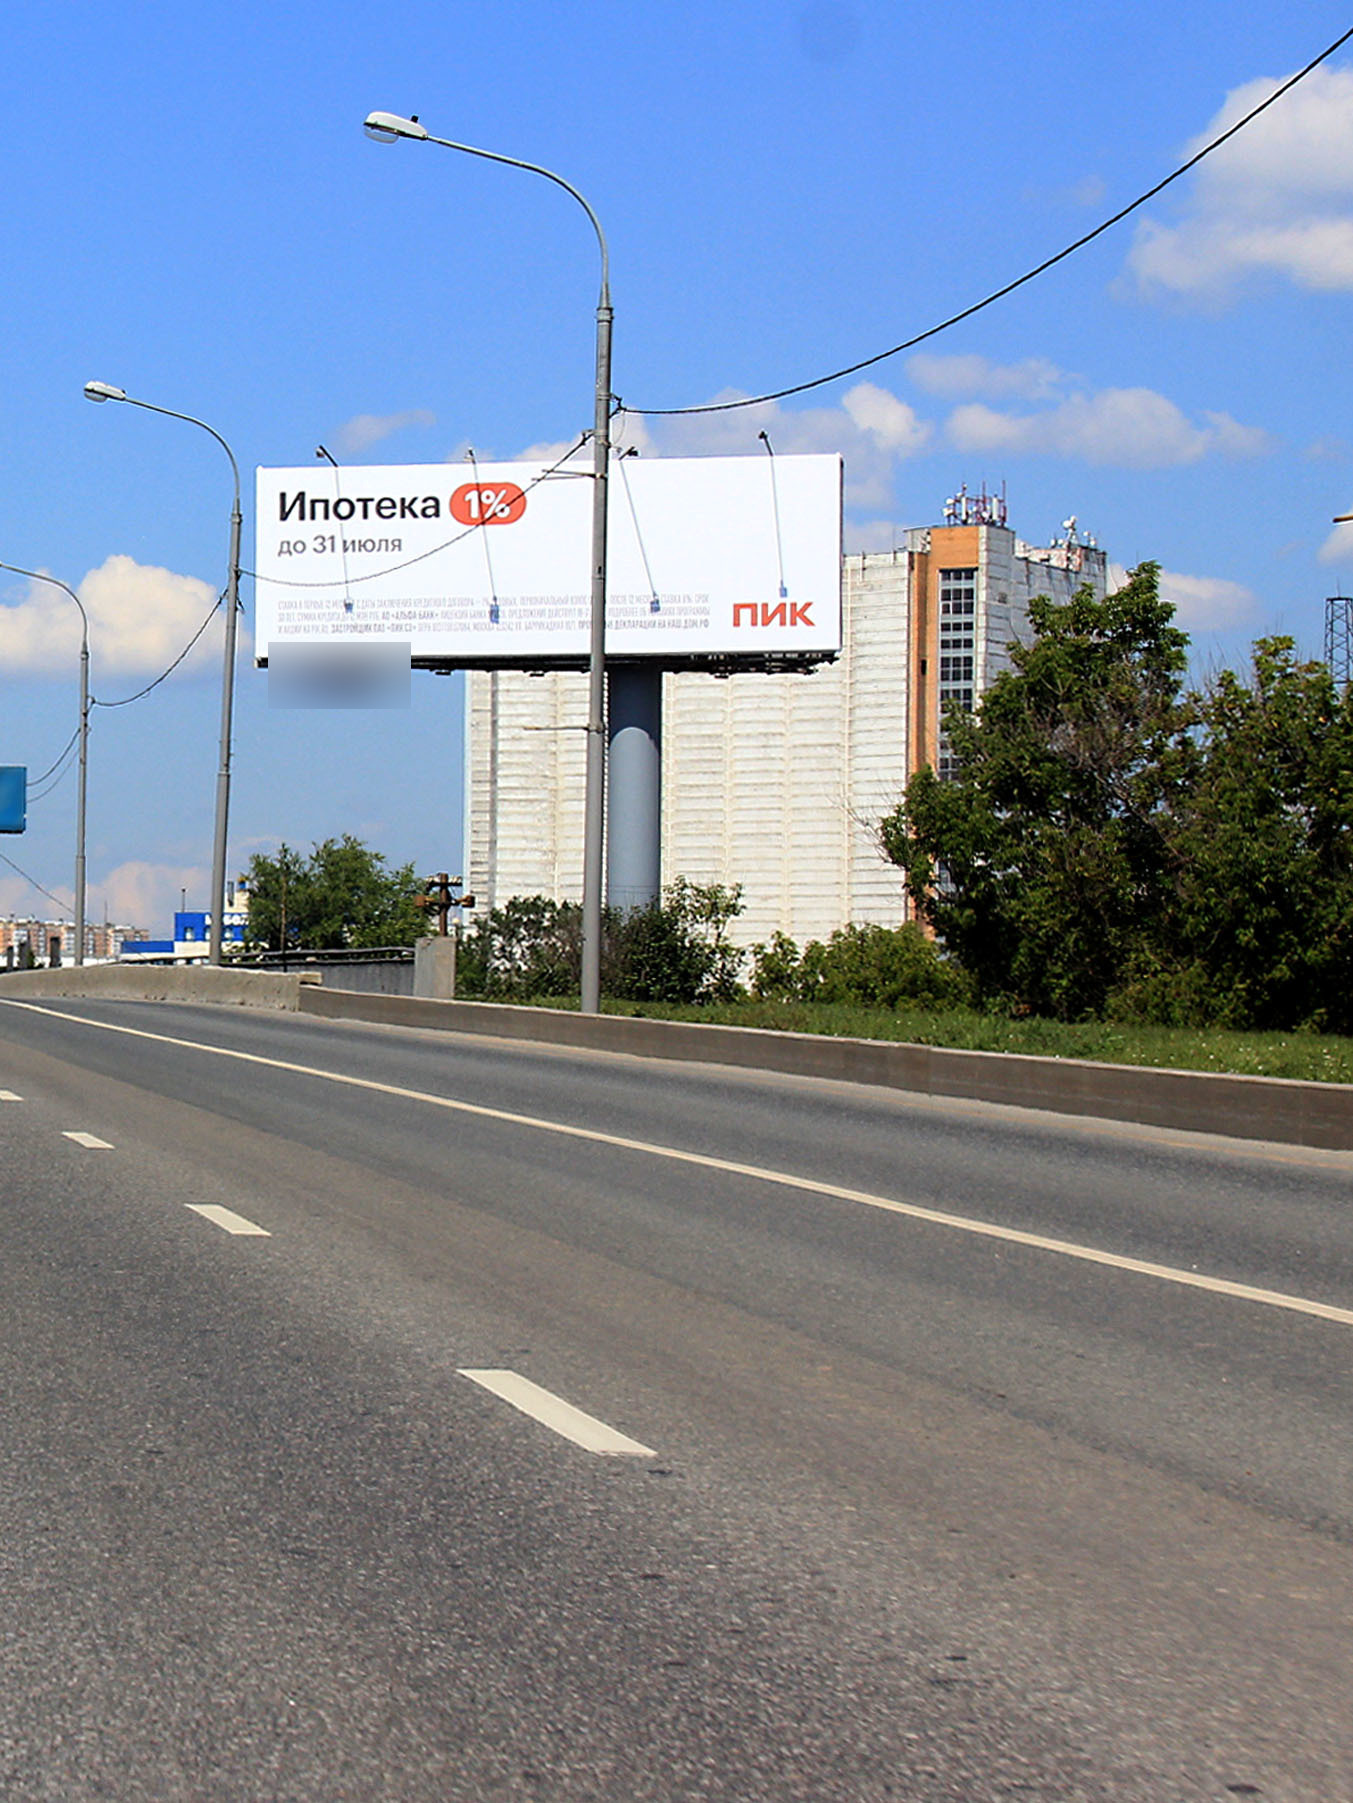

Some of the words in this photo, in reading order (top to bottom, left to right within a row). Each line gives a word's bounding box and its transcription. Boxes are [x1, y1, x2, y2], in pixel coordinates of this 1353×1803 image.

[279, 491, 441, 522] Ипотека
[463, 489, 511, 519] 1%
[277, 540, 306, 557] до
[313, 535, 335, 554] 31
[342, 537, 402, 554] июля
[733, 602, 816, 627] ПИК
